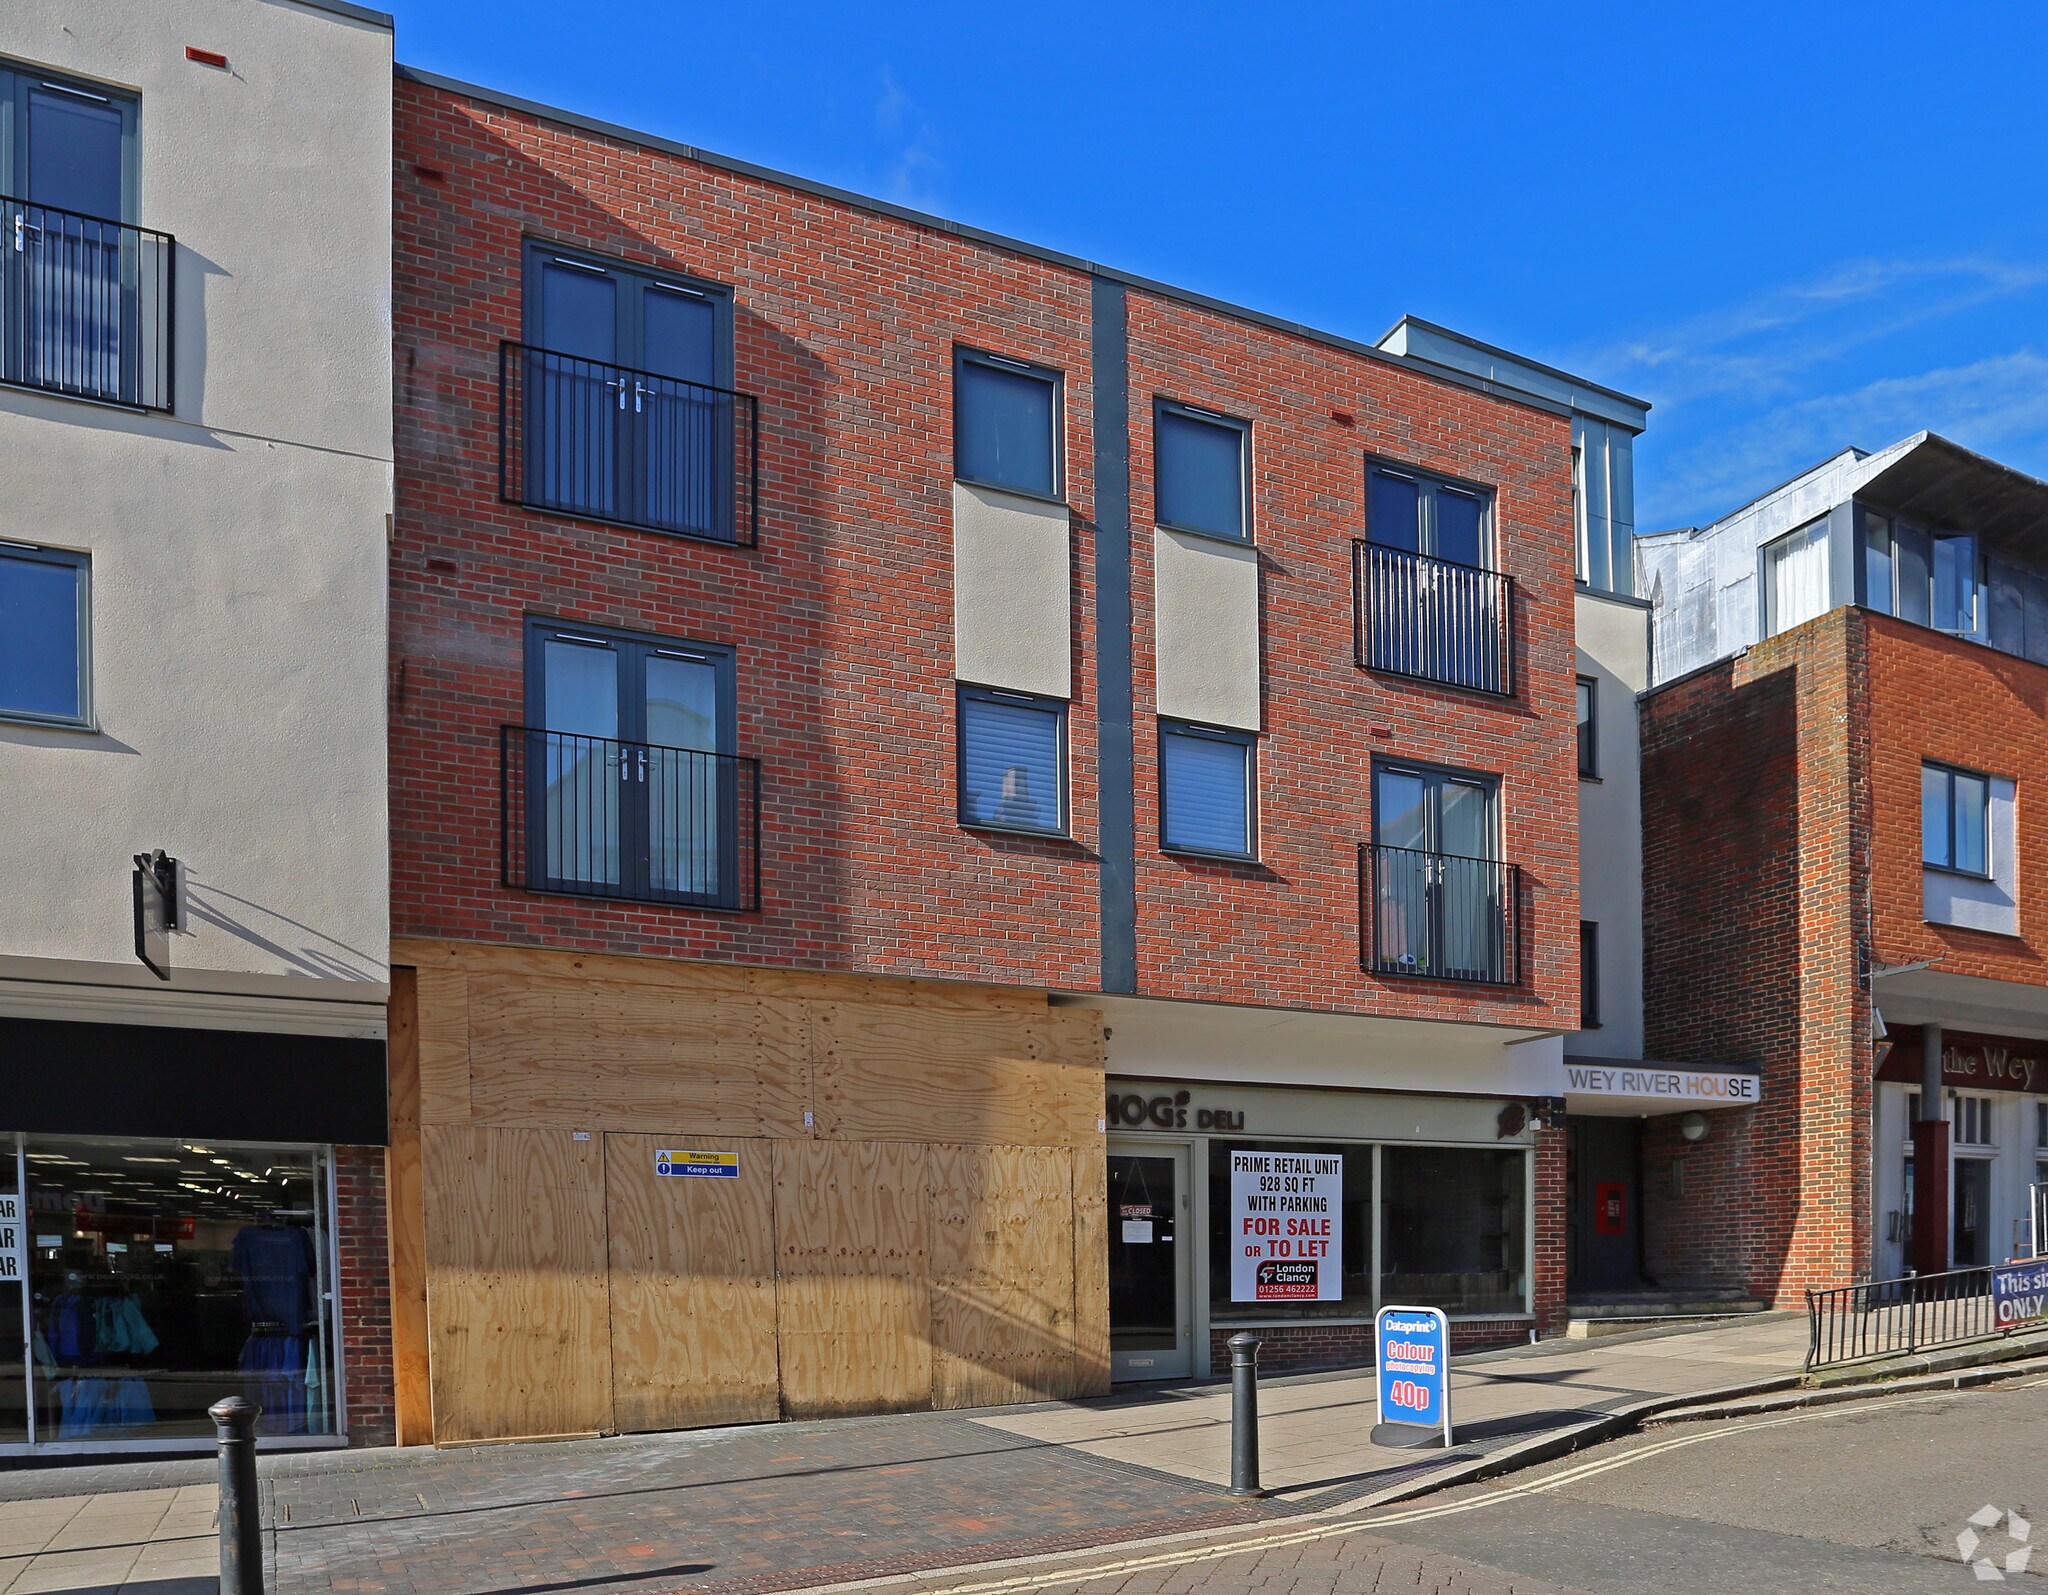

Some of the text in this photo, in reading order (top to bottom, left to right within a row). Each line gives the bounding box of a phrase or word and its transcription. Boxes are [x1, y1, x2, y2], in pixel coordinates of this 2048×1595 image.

[1942, 1046, 2036, 1090] the Wey
[1569, 1069, 1752, 1098] WEY RIVER HOUSE
[1198, 1109, 1245, 1130] DELI
[688, 1153, 720, 1161] Warning
[1234, 1156, 1340, 1175] PRIME RETAIL UNIT
[687, 1166, 708, 1174] Keep
[1260, 1176, 1315, 1193] 928 SQ FT
[1128, 1207, 1151, 1215] CLOSED
[1247, 1196, 1328, 1212] WITH PARKING
[1243, 1218, 1331, 1236] FOR SALE
[1245, 1239, 1329, 1257] OR TO LET
[1276, 1264, 1315, 1273] London
[1276, 1273, 1311, 1283] Clancy
[1997, 1267, 2048, 1294] This si
[1259, 1284, 1316, 1293] 01256 462222
[1999, 1294, 2045, 1322] ONLY
[1385, 1319, 1431, 1335] Dataprint
[1387, 1340, 1434, 1361] Colour
[1385, 1360, 1436, 1375] photocopying
[1391, 1380, 1429, 1410] 40p
